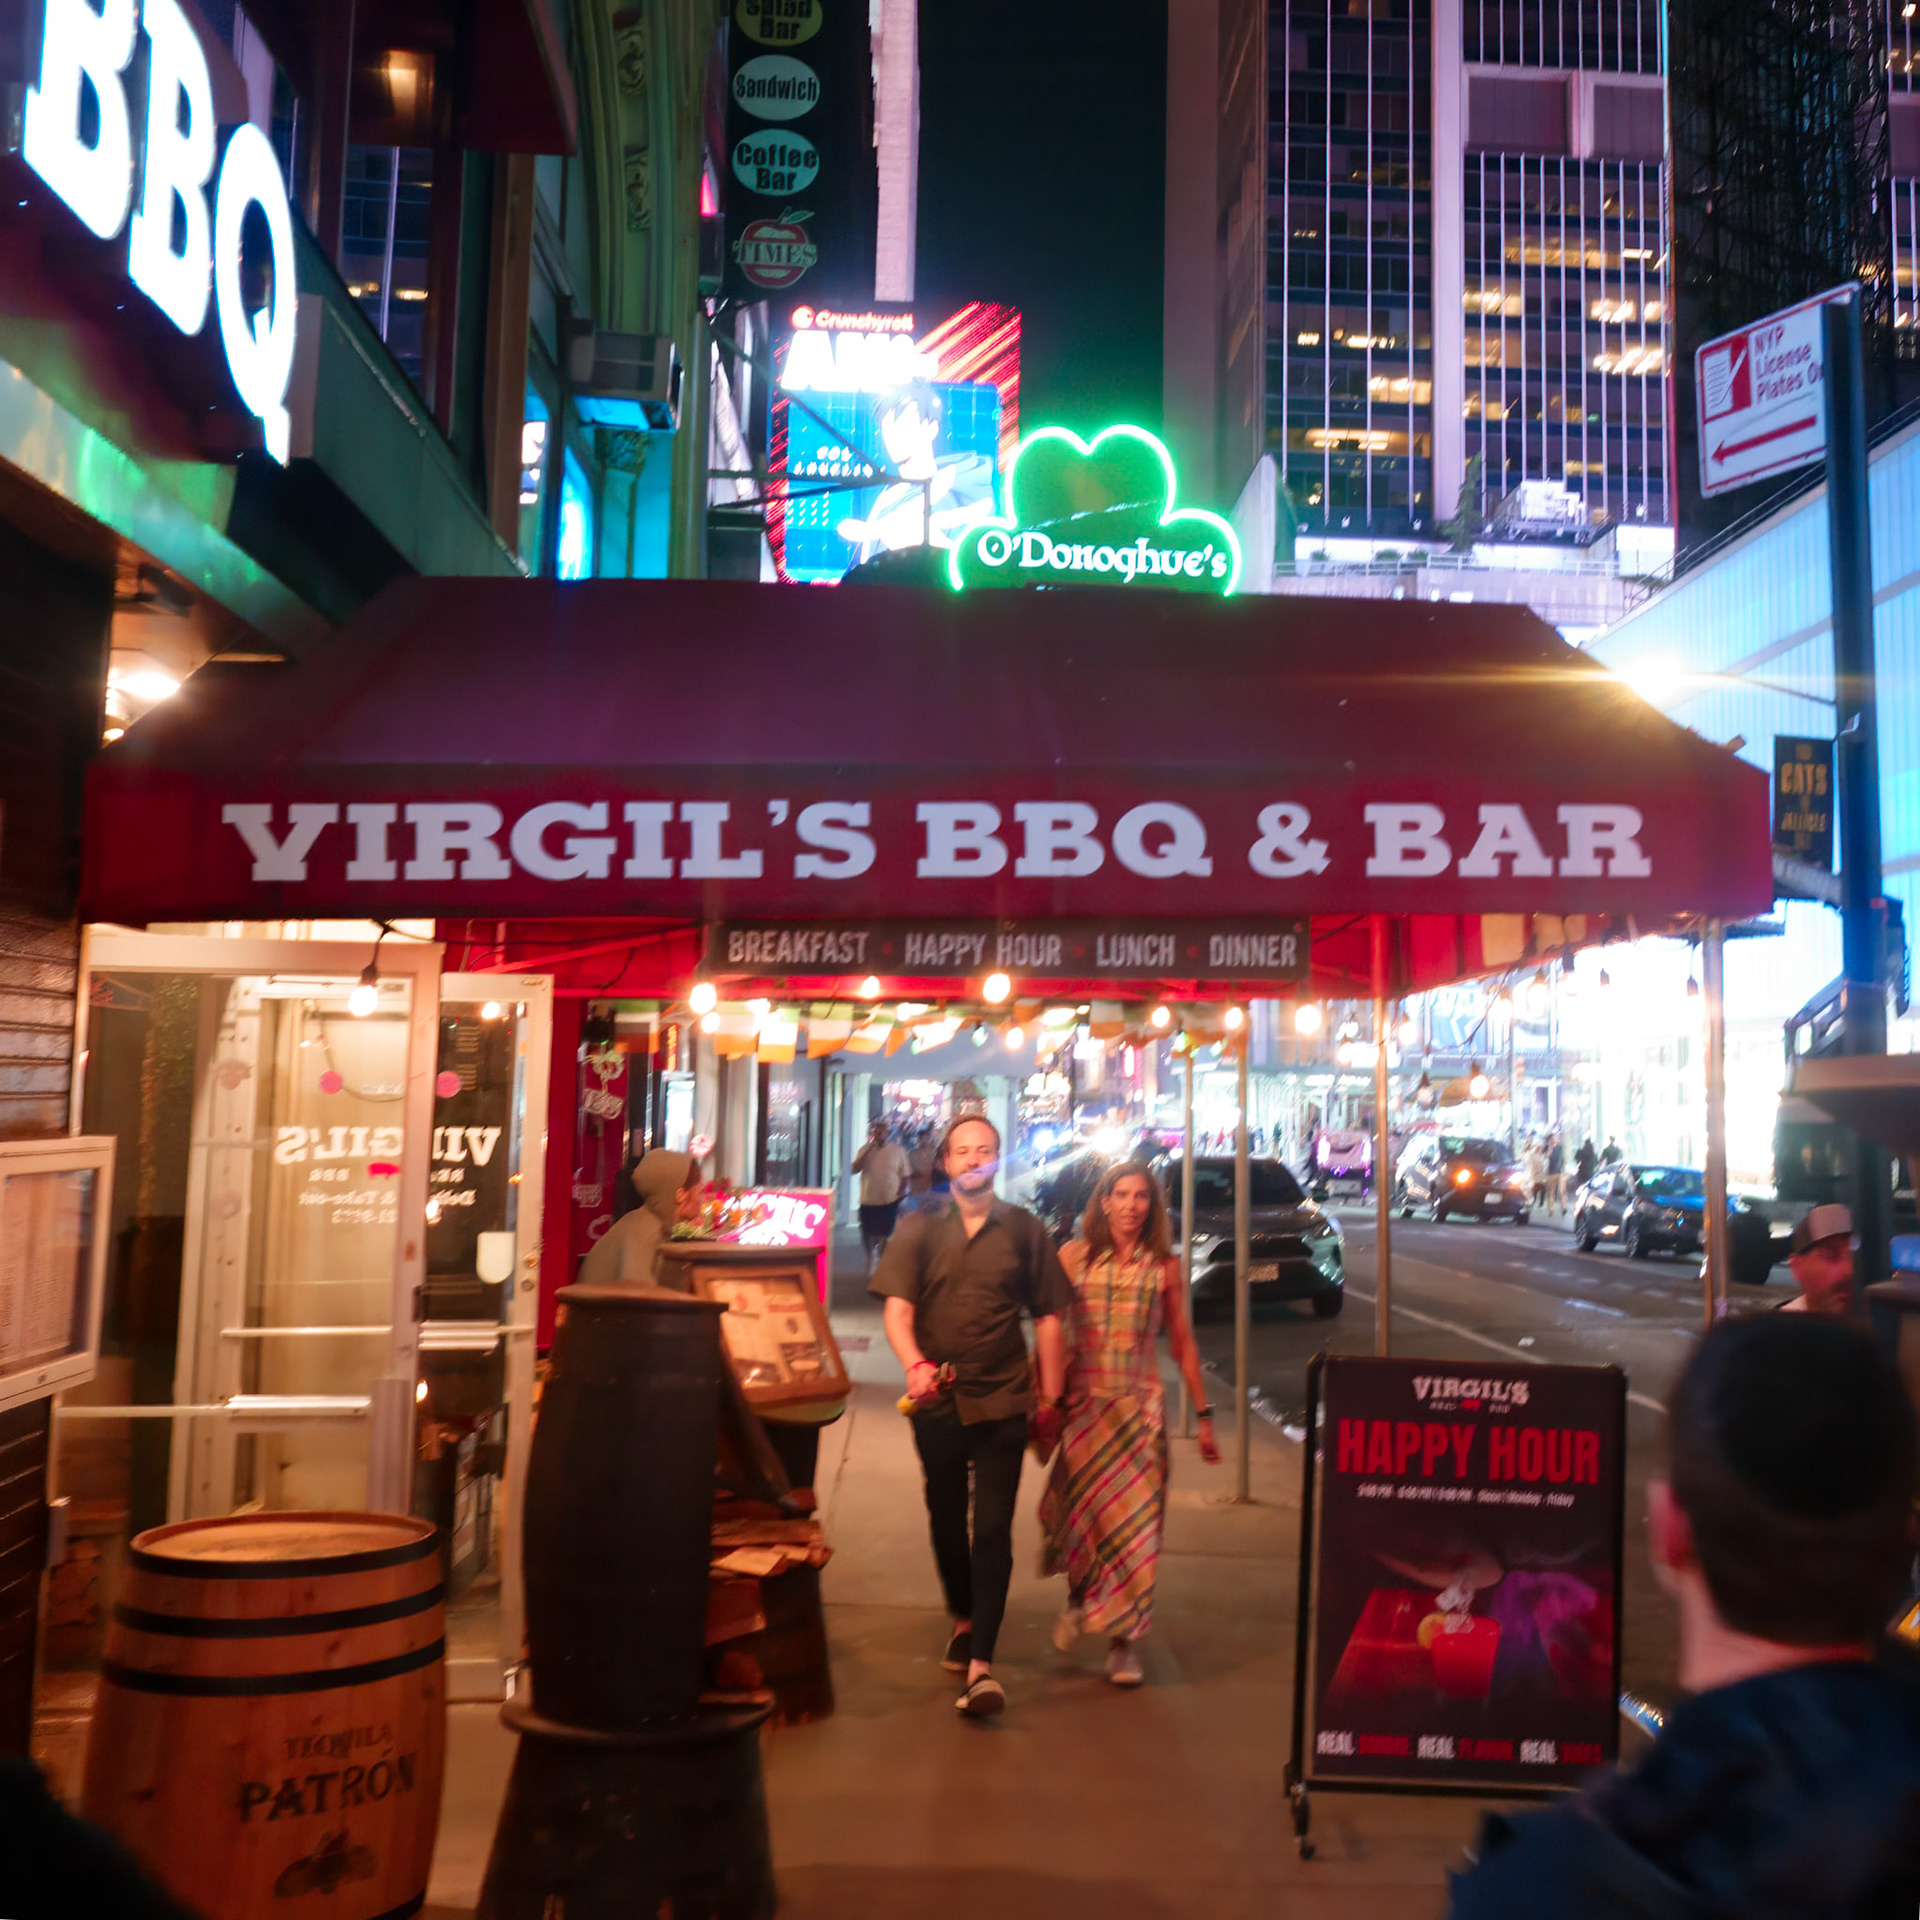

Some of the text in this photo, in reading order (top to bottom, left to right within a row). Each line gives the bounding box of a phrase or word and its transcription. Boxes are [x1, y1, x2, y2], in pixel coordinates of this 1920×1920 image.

[760, 19, 799, 40] Bar
[736, 74, 817, 102] Sandwich
[737, 143, 816, 168] Coffee
[756, 168, 797, 191] Bar
[23, 0, 298, 466] BBQ
[733, 240, 817, 267] TIMES
[1757, 344, 1811, 380] License
[1757, 374, 1804, 404] Plates
[977, 530, 1227, 584] O'Donoghue's
[222, 799, 1653, 881] VIRGIL'S BBQ & BAR
[728, 930, 1296, 967] BREAKFAST HAPPY HOUR LUNCH DINNER
[1412, 1375, 1530, 1405] VIRGIL'S
[1337, 1417, 1599, 1485] HAPPY HOUR
[239, 1748, 418, 1823] PATRÓN
